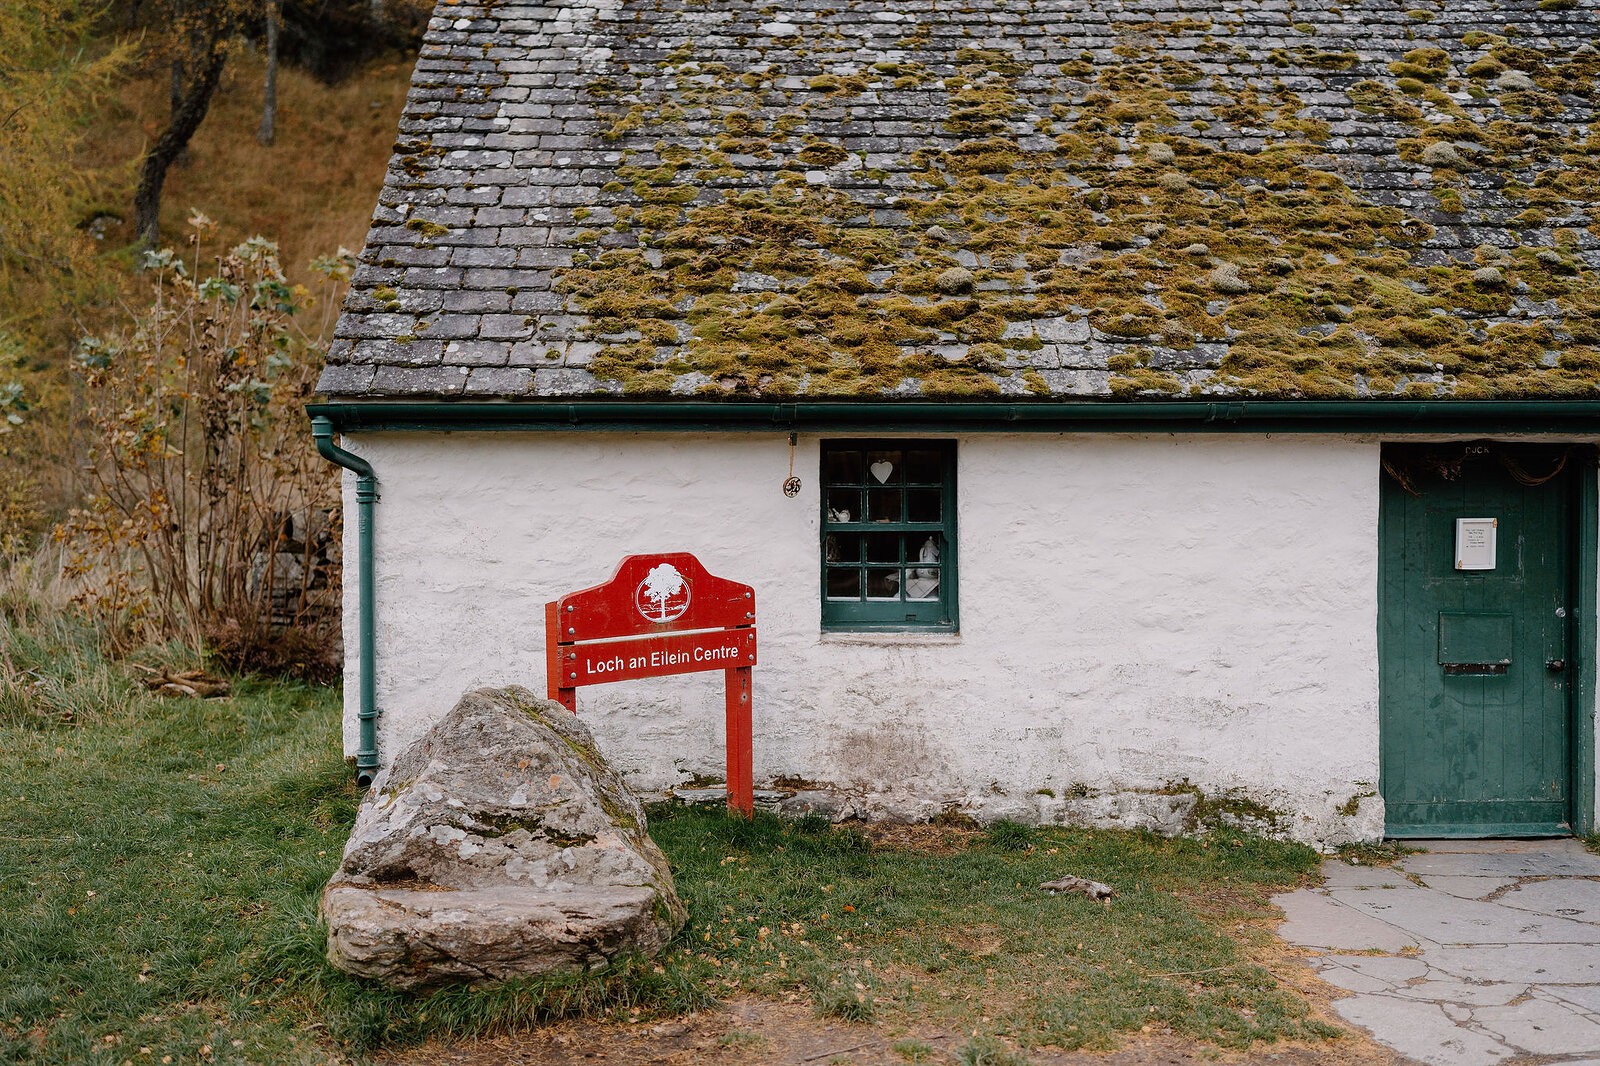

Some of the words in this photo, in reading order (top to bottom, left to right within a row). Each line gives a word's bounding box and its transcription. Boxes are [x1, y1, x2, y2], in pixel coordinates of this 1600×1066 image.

[586, 655, 624, 674] Loch
[629, 656, 647, 669] an
[651, 650, 690, 667] Eilein
[693, 645, 739, 662] Centre
